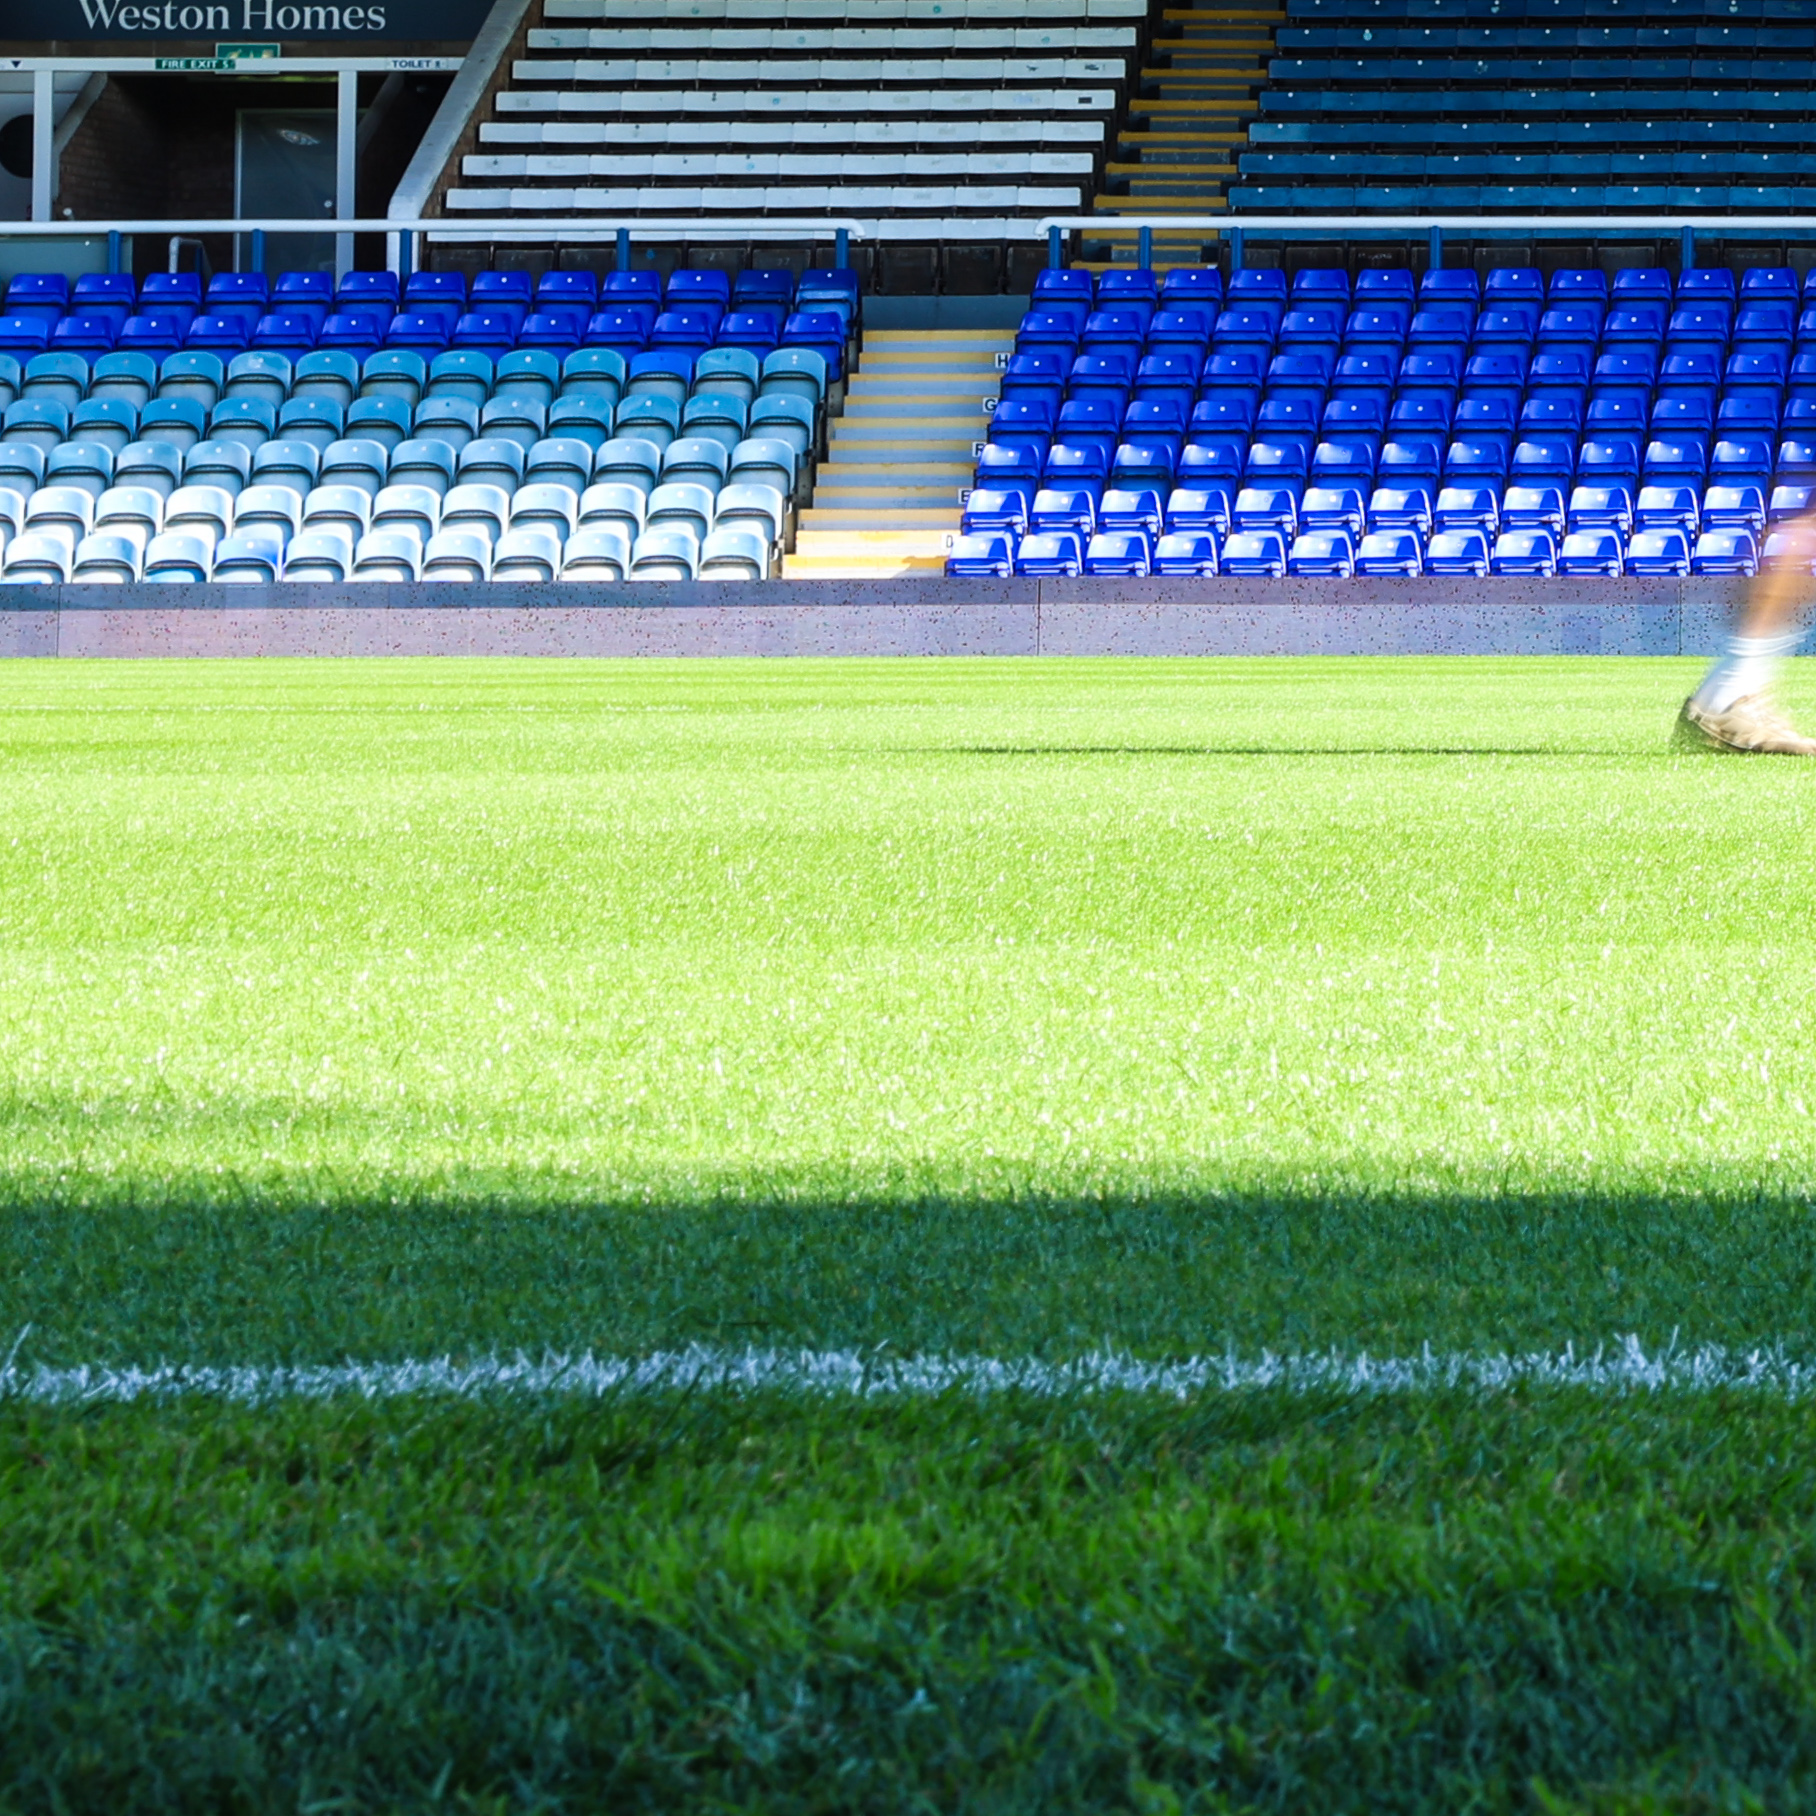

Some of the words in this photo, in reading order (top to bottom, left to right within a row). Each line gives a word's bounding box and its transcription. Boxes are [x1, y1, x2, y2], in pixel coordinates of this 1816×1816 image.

[162, 60, 186, 69] FIRE
[191, 60, 217, 69] EXIT
[392, 60, 431, 69] TOILET
[997, 354, 1009, 368] H
[984, 398, 996, 412] G
